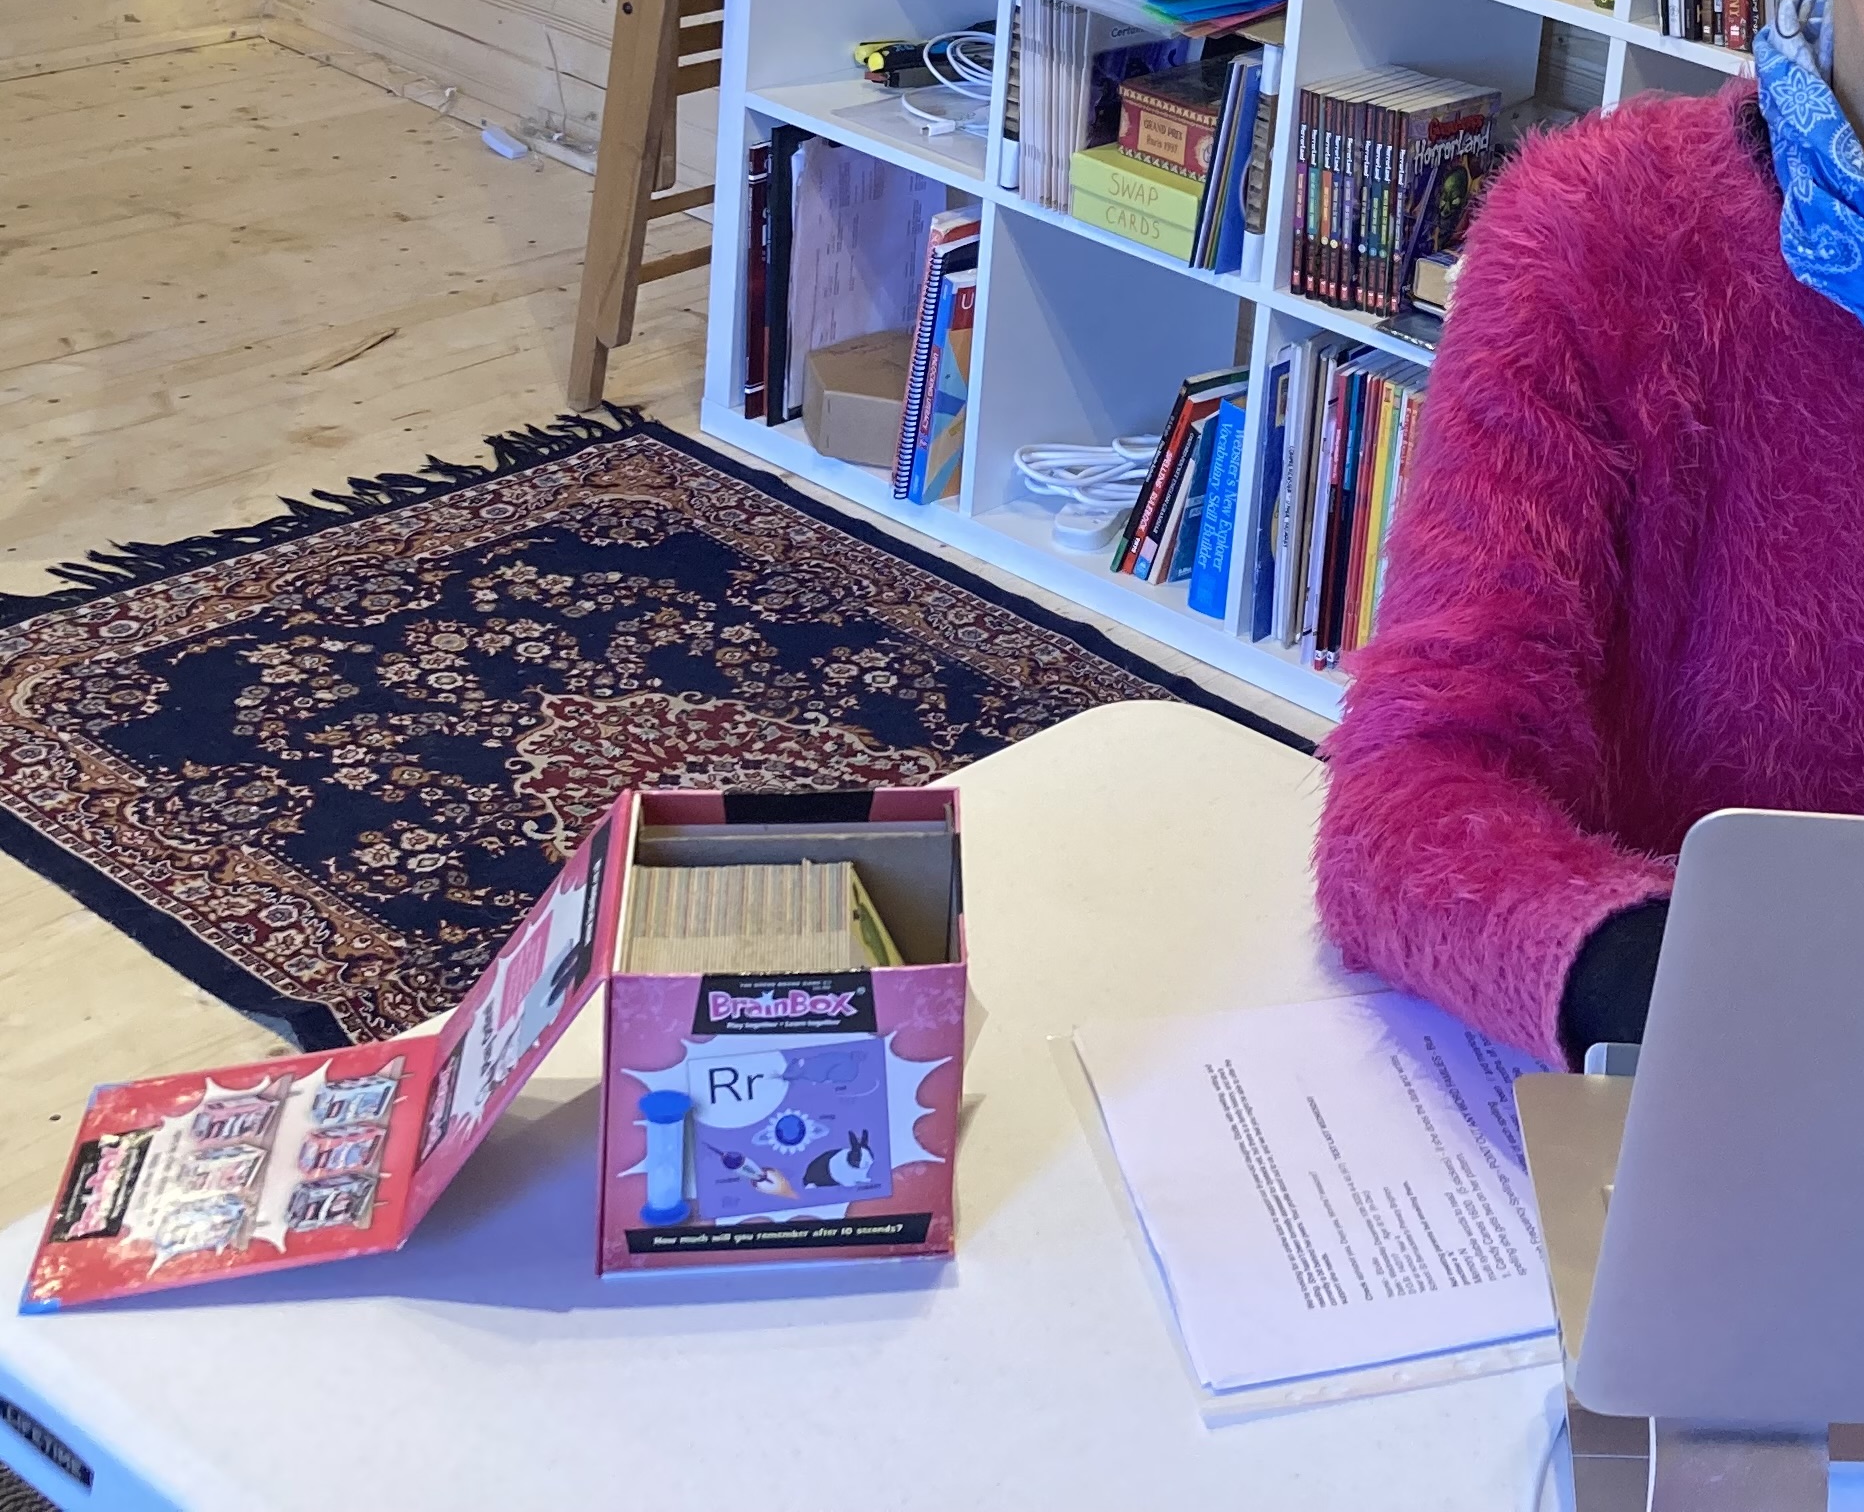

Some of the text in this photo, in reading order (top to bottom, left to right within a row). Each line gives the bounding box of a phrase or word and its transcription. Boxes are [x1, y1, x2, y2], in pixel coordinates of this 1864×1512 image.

[1414, 121, 1490, 176] HorrorLand
[1109, 172, 1159, 207] SWAP
[1106, 206, 1160, 239] CARDS
[1155, 449, 1173, 489] SPELLING
[1198, 423, 1233, 570] Vocabulary Skill Builder
[1212, 429, 1244, 572] Webster's New Explorer
[708, 989, 859, 1021] BrainBox
[708, 1066, 764, 1105] Rr
[653, 1223, 904, 1245] How much will you remember after 10 seconds?
